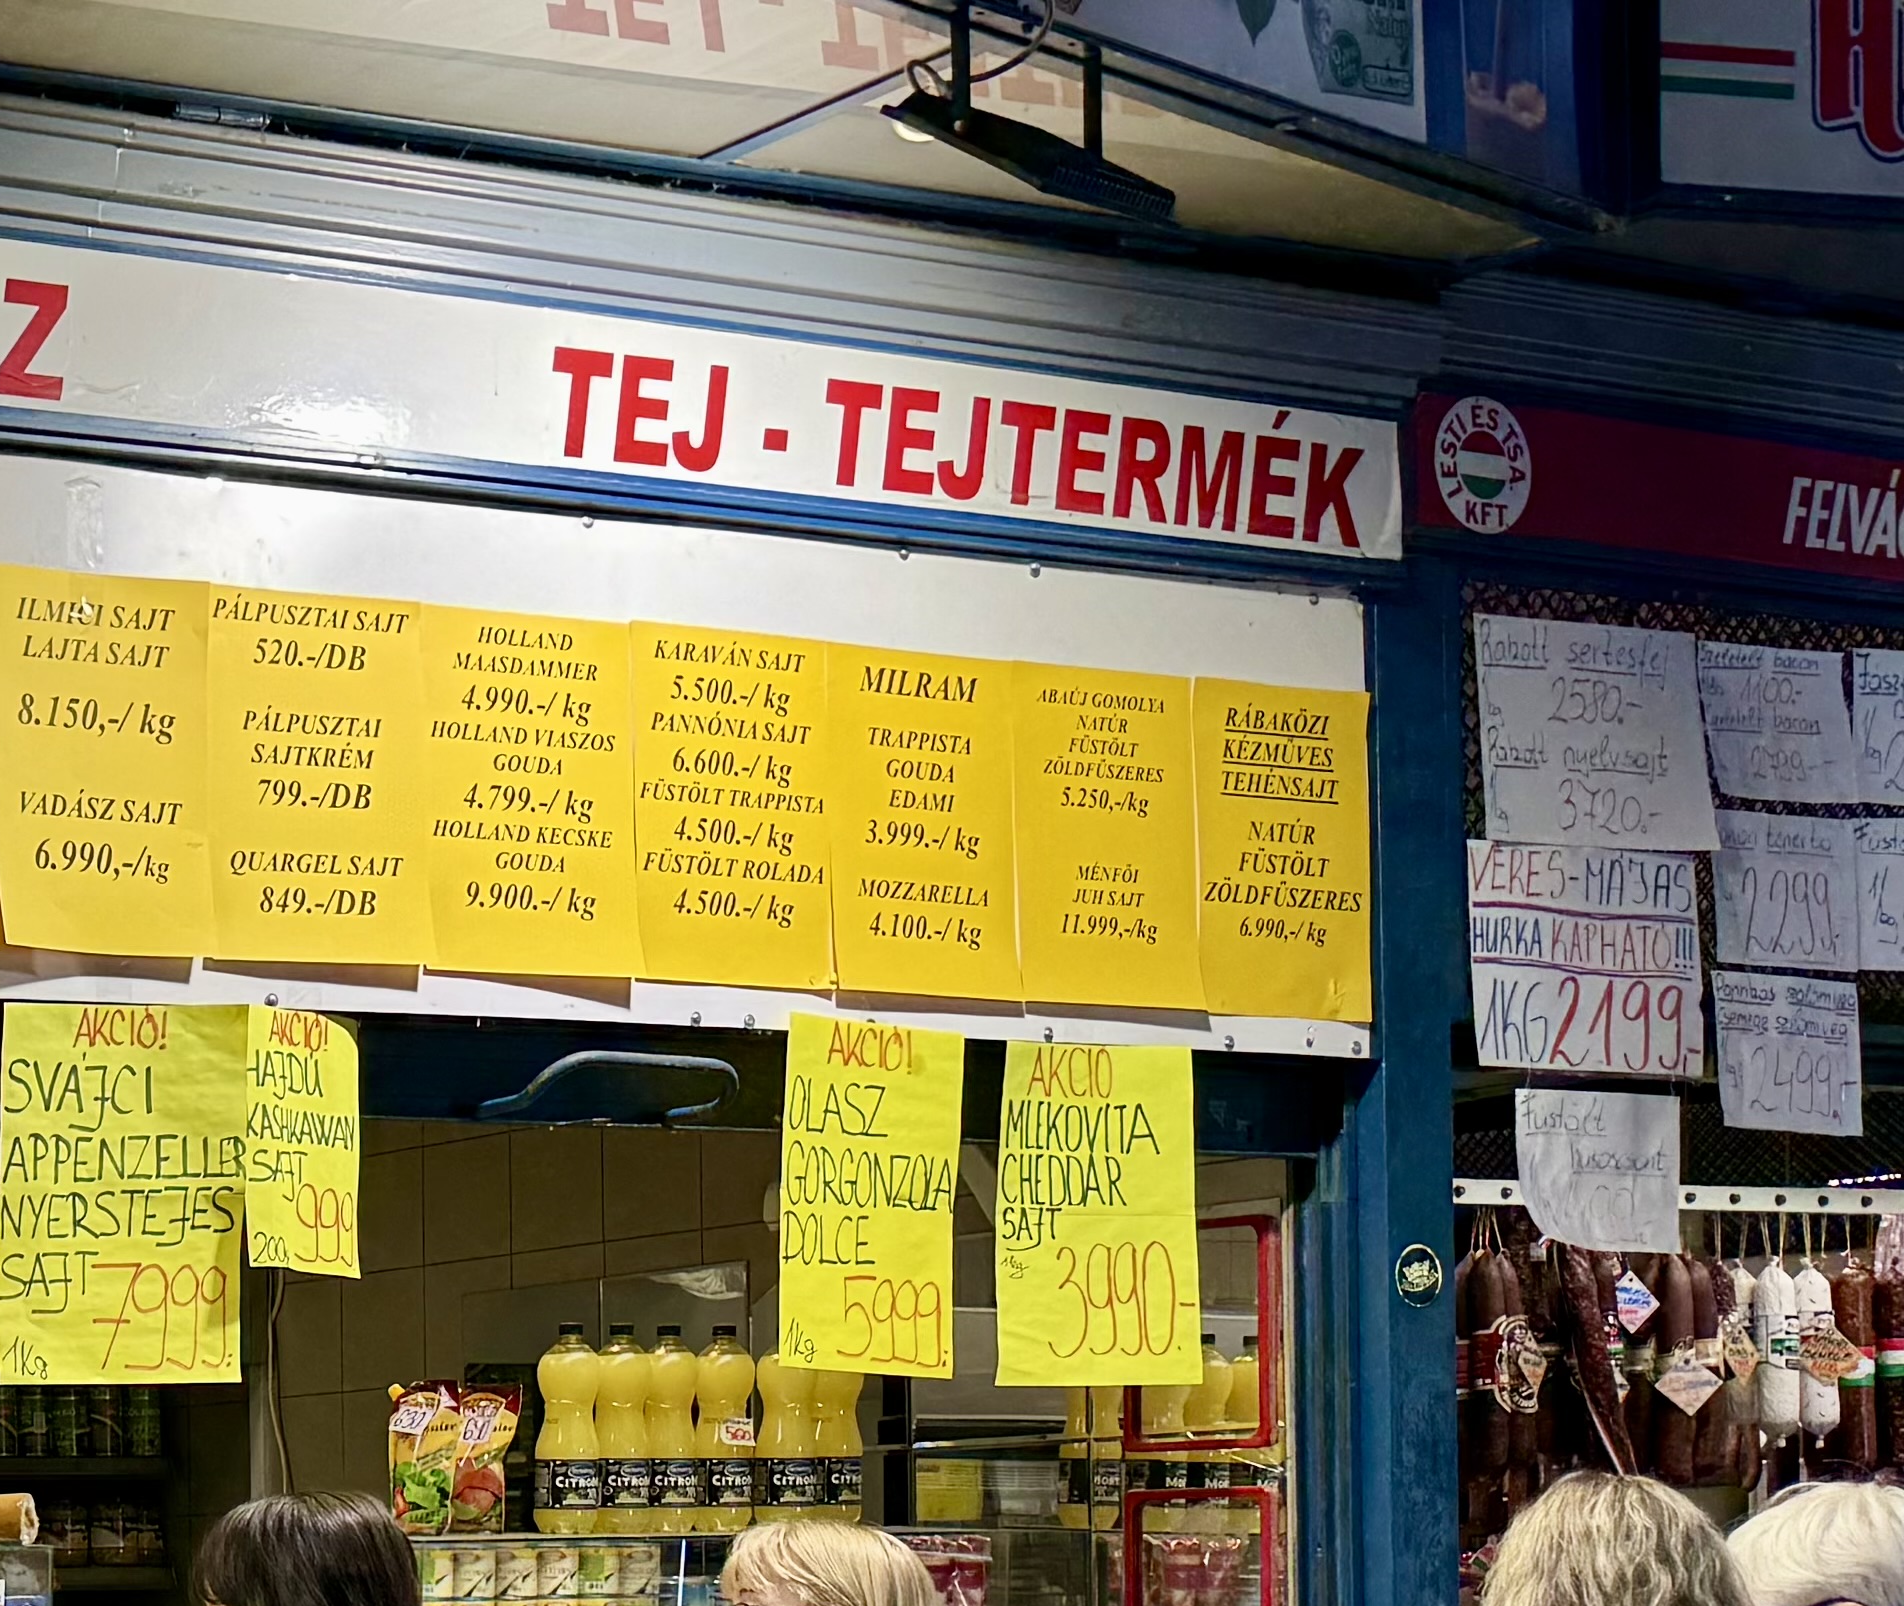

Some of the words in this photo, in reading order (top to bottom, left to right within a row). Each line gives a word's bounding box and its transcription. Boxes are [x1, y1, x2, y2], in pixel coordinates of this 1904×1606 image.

[1470, 398, 1500, 431] ÉS
[552, 345, 729, 474] TEJ
[825, 378, 1364, 548] TEJTERMÉK
[211, 593, 349, 628] PÁLPUSZTAI
[353, 609, 409, 634] SAJT
[22, 635, 99, 663] LAJTA
[105, 641, 170, 669] SAJT
[253, 638, 367, 671] 520.-/DB
[477, 626, 573, 651] HOLLAND
[654, 639, 753, 668] KARAVÁN
[756, 649, 805, 673] SAJT
[453, 652, 598, 681] MAASDAMMER
[859, 665, 979, 703] MILRAM
[461, 684, 558, 716] 4.990.-/
[563, 694, 591, 727] kg
[1036, 687, 1088, 707] ABAÚJ
[1091, 692, 1165, 714] GOMOLYA
[1224, 704, 1330, 739] RÁBAKÖZI
[867, 727, 972, 755] TRAPPISTA
[886, 759, 956, 784] GOUDA
[1221, 767, 1340, 802] TEHÉNSAJT
[19, 789, 114, 821] VADÁSZ
[121, 799, 182, 826] SAJT
[640, 779, 725, 805] FÜSTÖLT
[729, 789, 824, 814] TRAPPISTA
[1060, 786, 1150, 817] 5.250,-/kg
[865, 819, 948, 849] 3.999.-/
[954, 828, 980, 859] kg
[230, 850, 342, 878] QUARGEL
[347, 855, 403, 877] SAJT
[858, 878, 989, 907] MOZZARELLA
[1072, 887, 1104, 906] JUH
[1107, 889, 1145, 909] SAJT
[1060, 912, 1158, 944] 11.999,-/kg
[1473, 916, 1541, 957] HURKA
[1480, 978, 1547, 1063] 1KG
[2, 1133, 246, 1184] APPENZELLER
[786, 1140, 953, 1213] GORGONZOLA
[1001, 1154, 1127, 1207] CHEDDAR
[0, 1185, 235, 1247] NYERSTEJES
[782, 1211, 876, 1266] DOLCE
